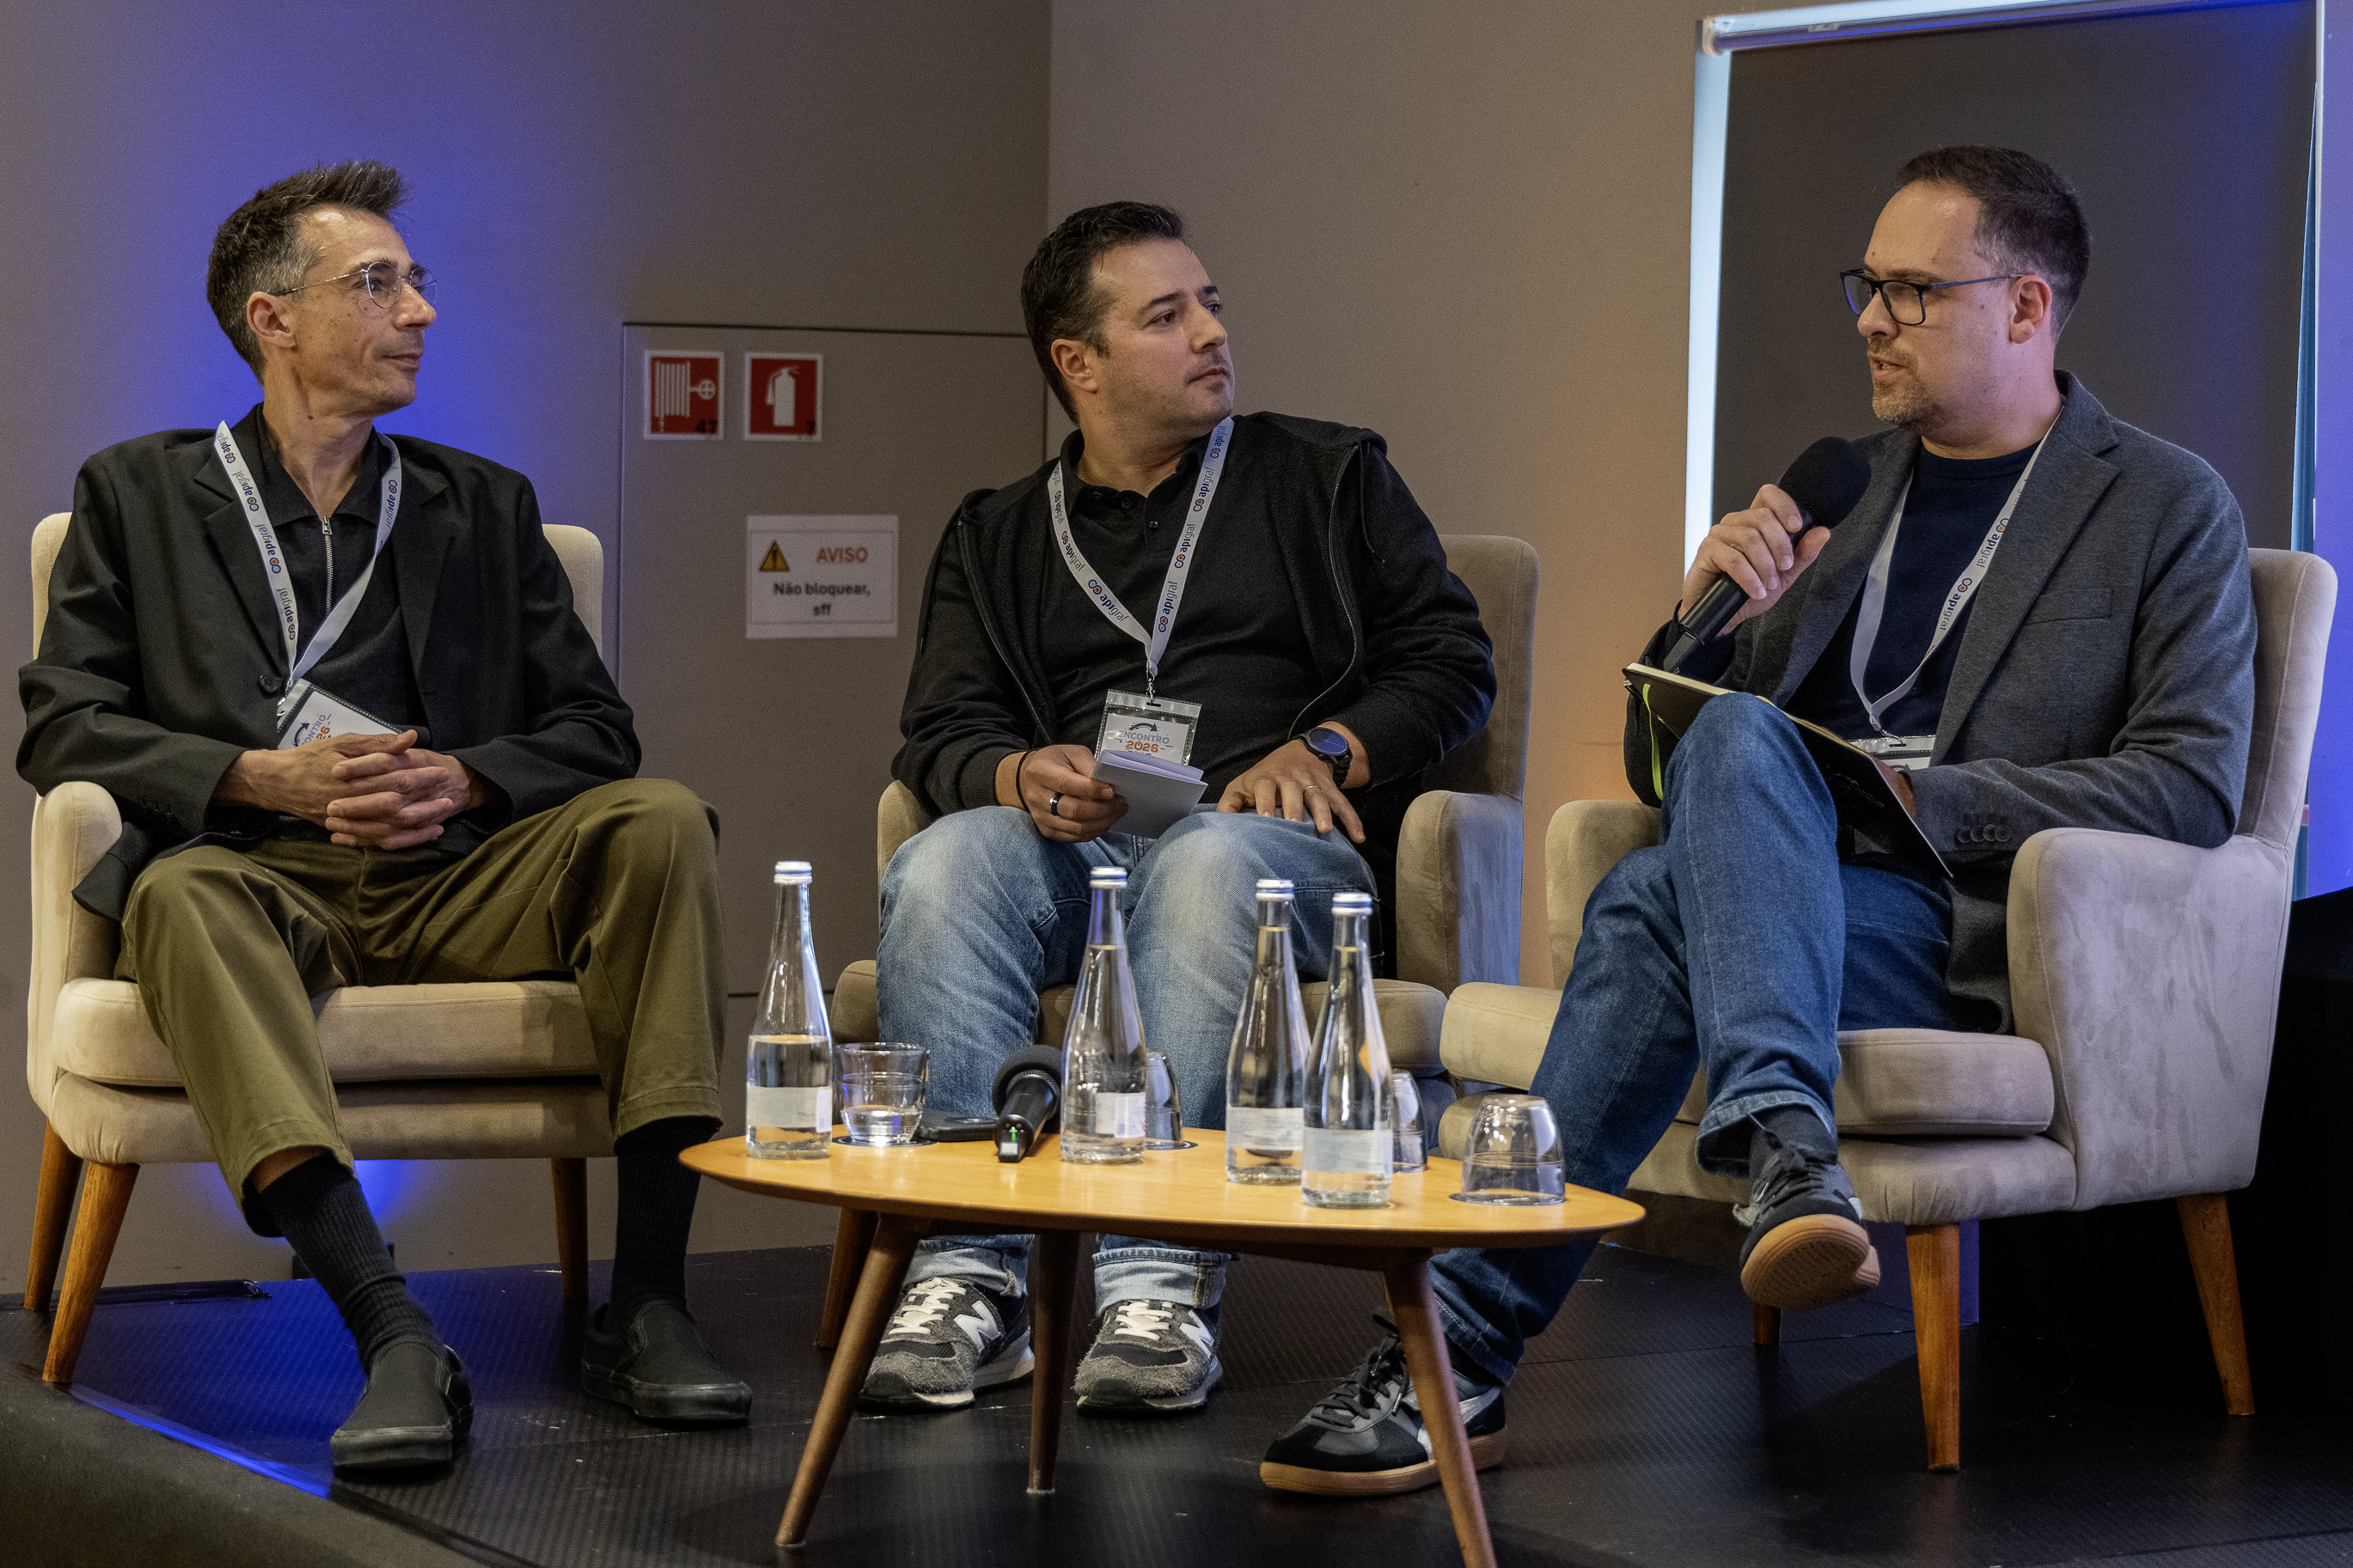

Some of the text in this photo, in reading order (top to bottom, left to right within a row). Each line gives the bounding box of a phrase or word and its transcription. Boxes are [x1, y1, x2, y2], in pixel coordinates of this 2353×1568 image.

[231, 471, 254, 496] apigraf
[1199, 467, 1215, 497] apigraf
[386, 494, 396, 528] apigraf
[254, 523, 277, 556] apigraf
[1181, 523, 1196, 552] apigraf
[1977, 533, 2001, 568] apigraf
[817, 547, 868, 564] AVISO
[1066, 545, 1086, 571] apigraf
[774, 582, 871, 597] Não bloquear,
[1162, 581, 1178, 614] apigraf
[276, 588, 295, 623] apigraf
[1100, 594, 1130, 622] apigraf
[1940, 593, 1961, 631] apigraf
[303, 715, 327, 743] ONTRO
[316, 726, 331, 740] 26
[1119, 730, 1170, 744] ENCONTRO
[1126, 741, 1158, 753] 2026
